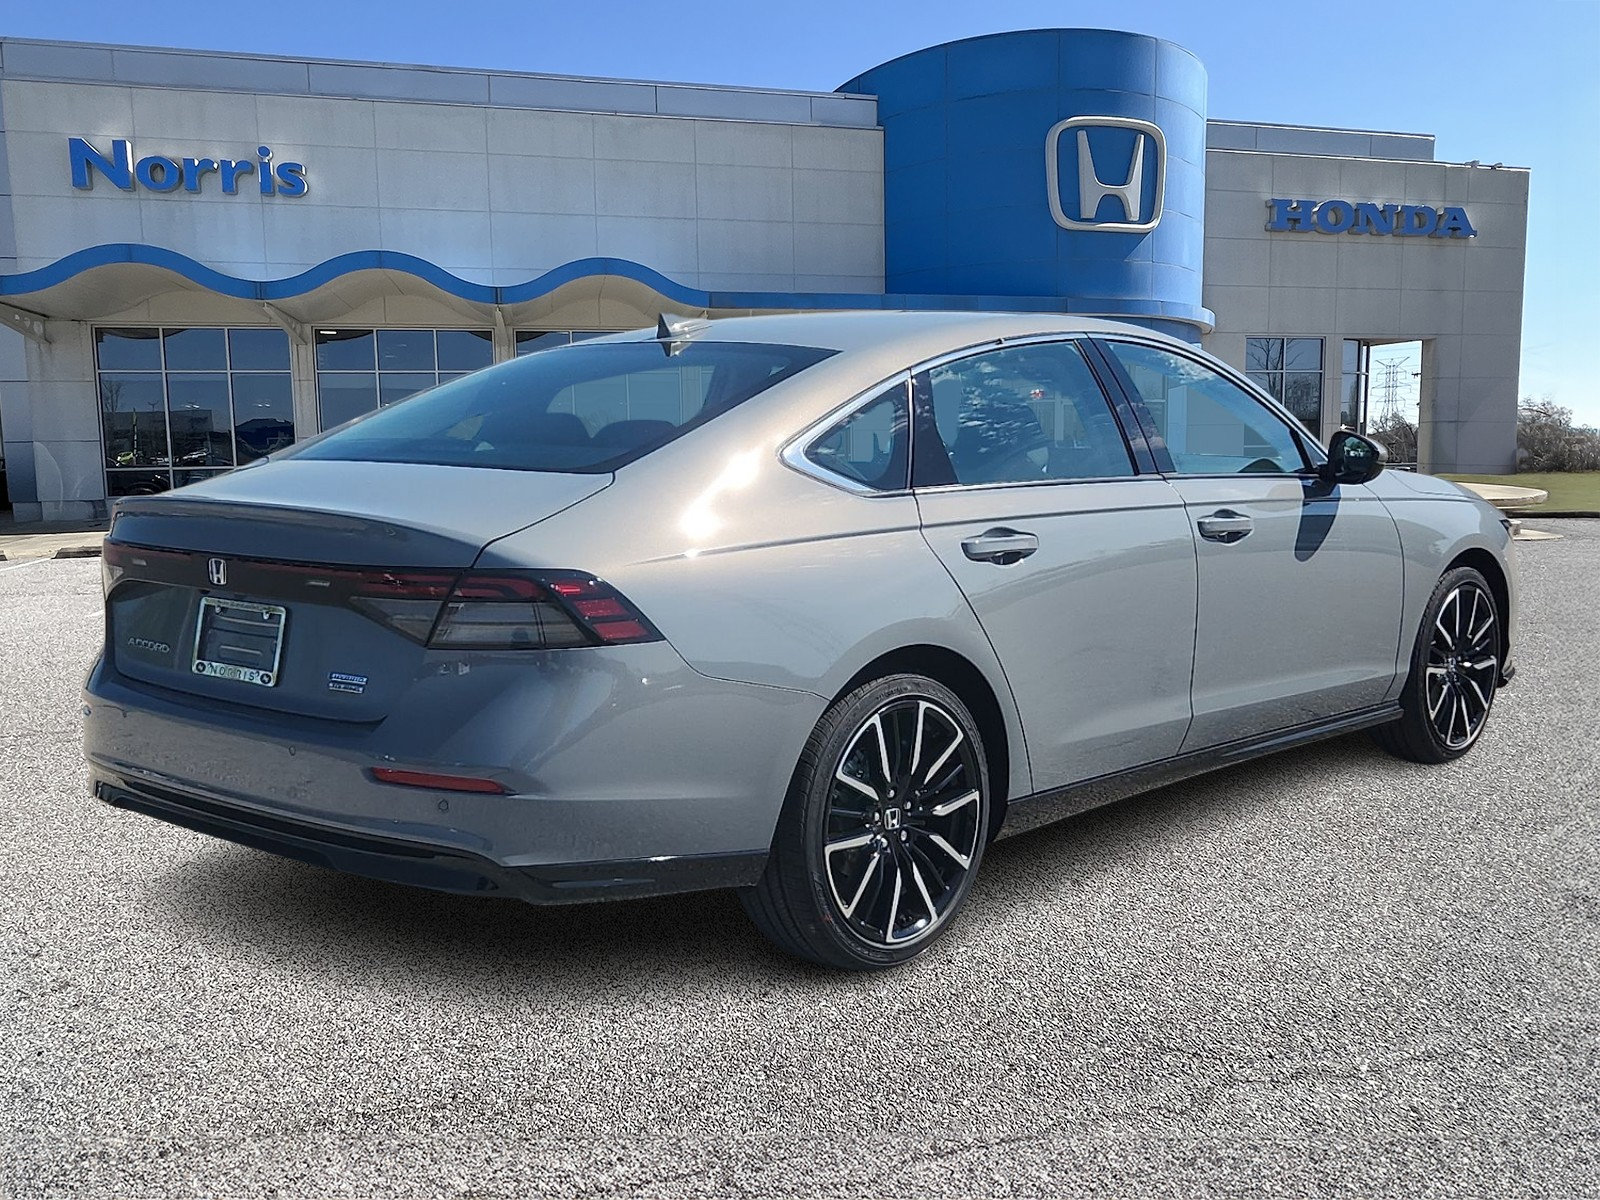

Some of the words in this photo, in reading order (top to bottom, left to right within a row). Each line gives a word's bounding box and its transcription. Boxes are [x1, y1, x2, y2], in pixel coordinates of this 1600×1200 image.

[67, 137, 309, 198] Norris
[1265, 198, 1478, 239] HONDA
[127, 637, 170, 653] ACCORD
